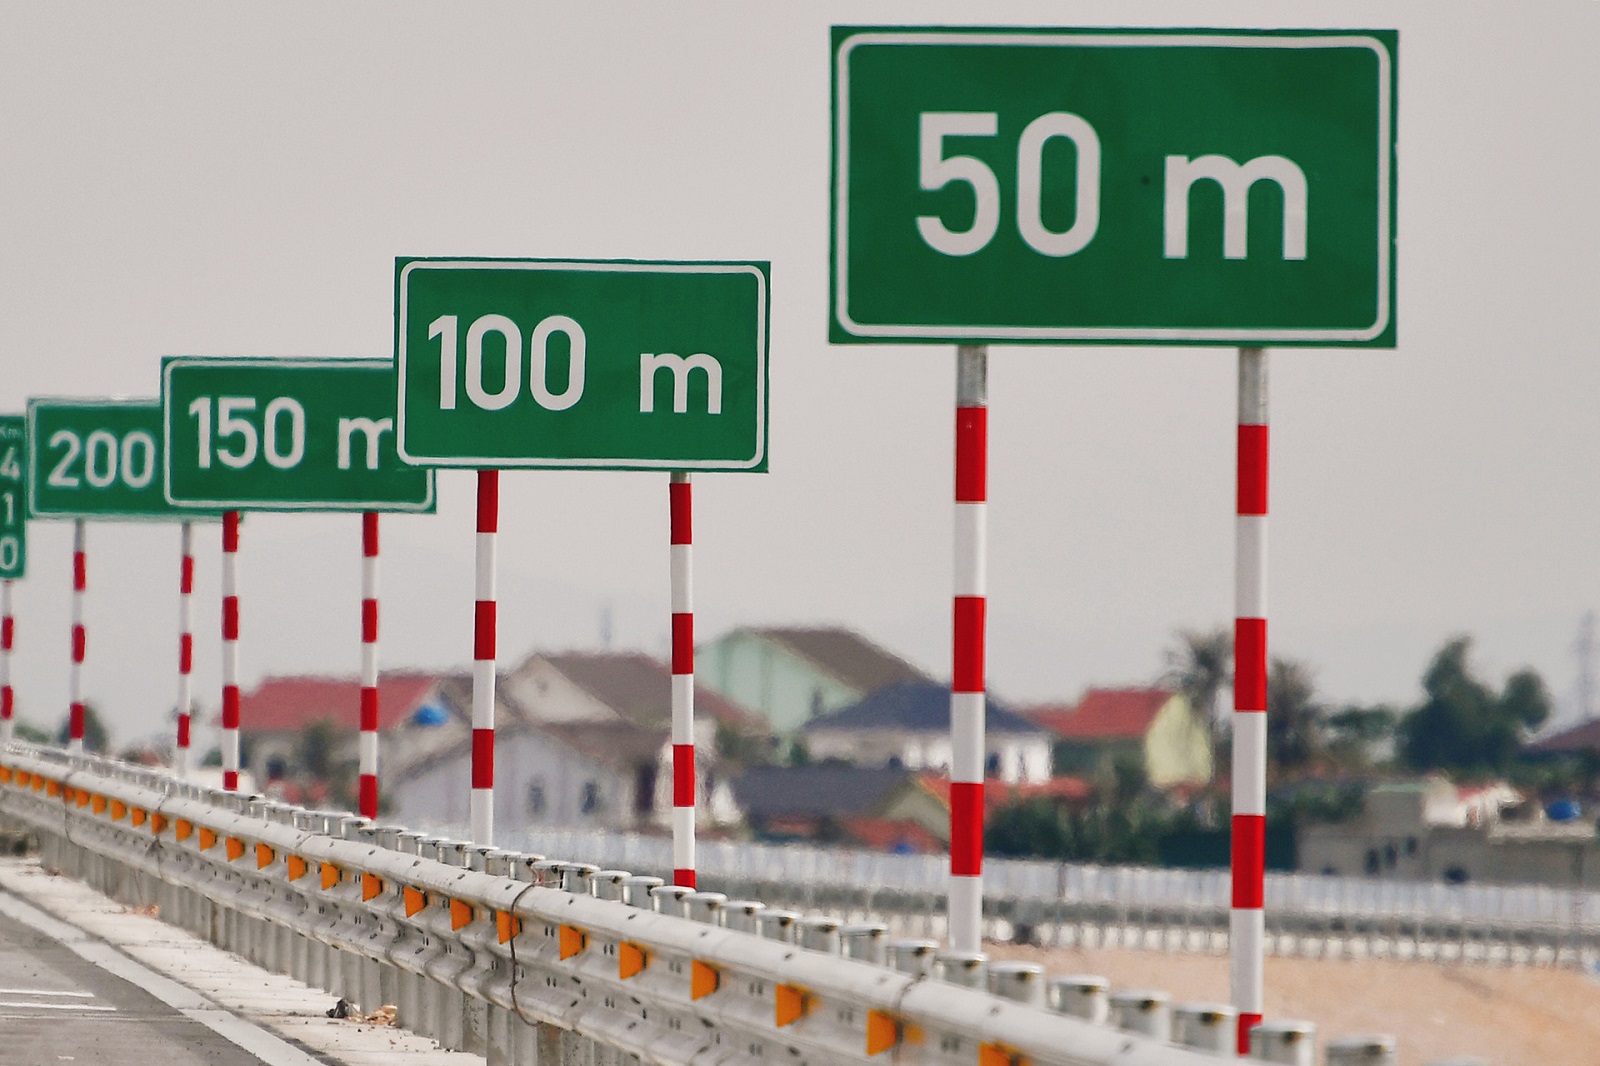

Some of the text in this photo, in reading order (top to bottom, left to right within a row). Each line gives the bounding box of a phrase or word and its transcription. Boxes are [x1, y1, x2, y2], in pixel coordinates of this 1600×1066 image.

[917, 111, 1308, 261] 50 m
[427, 313, 724, 415] 100 m
[47, 430, 156, 488] 200
[188, 396, 393, 470] 150 m
